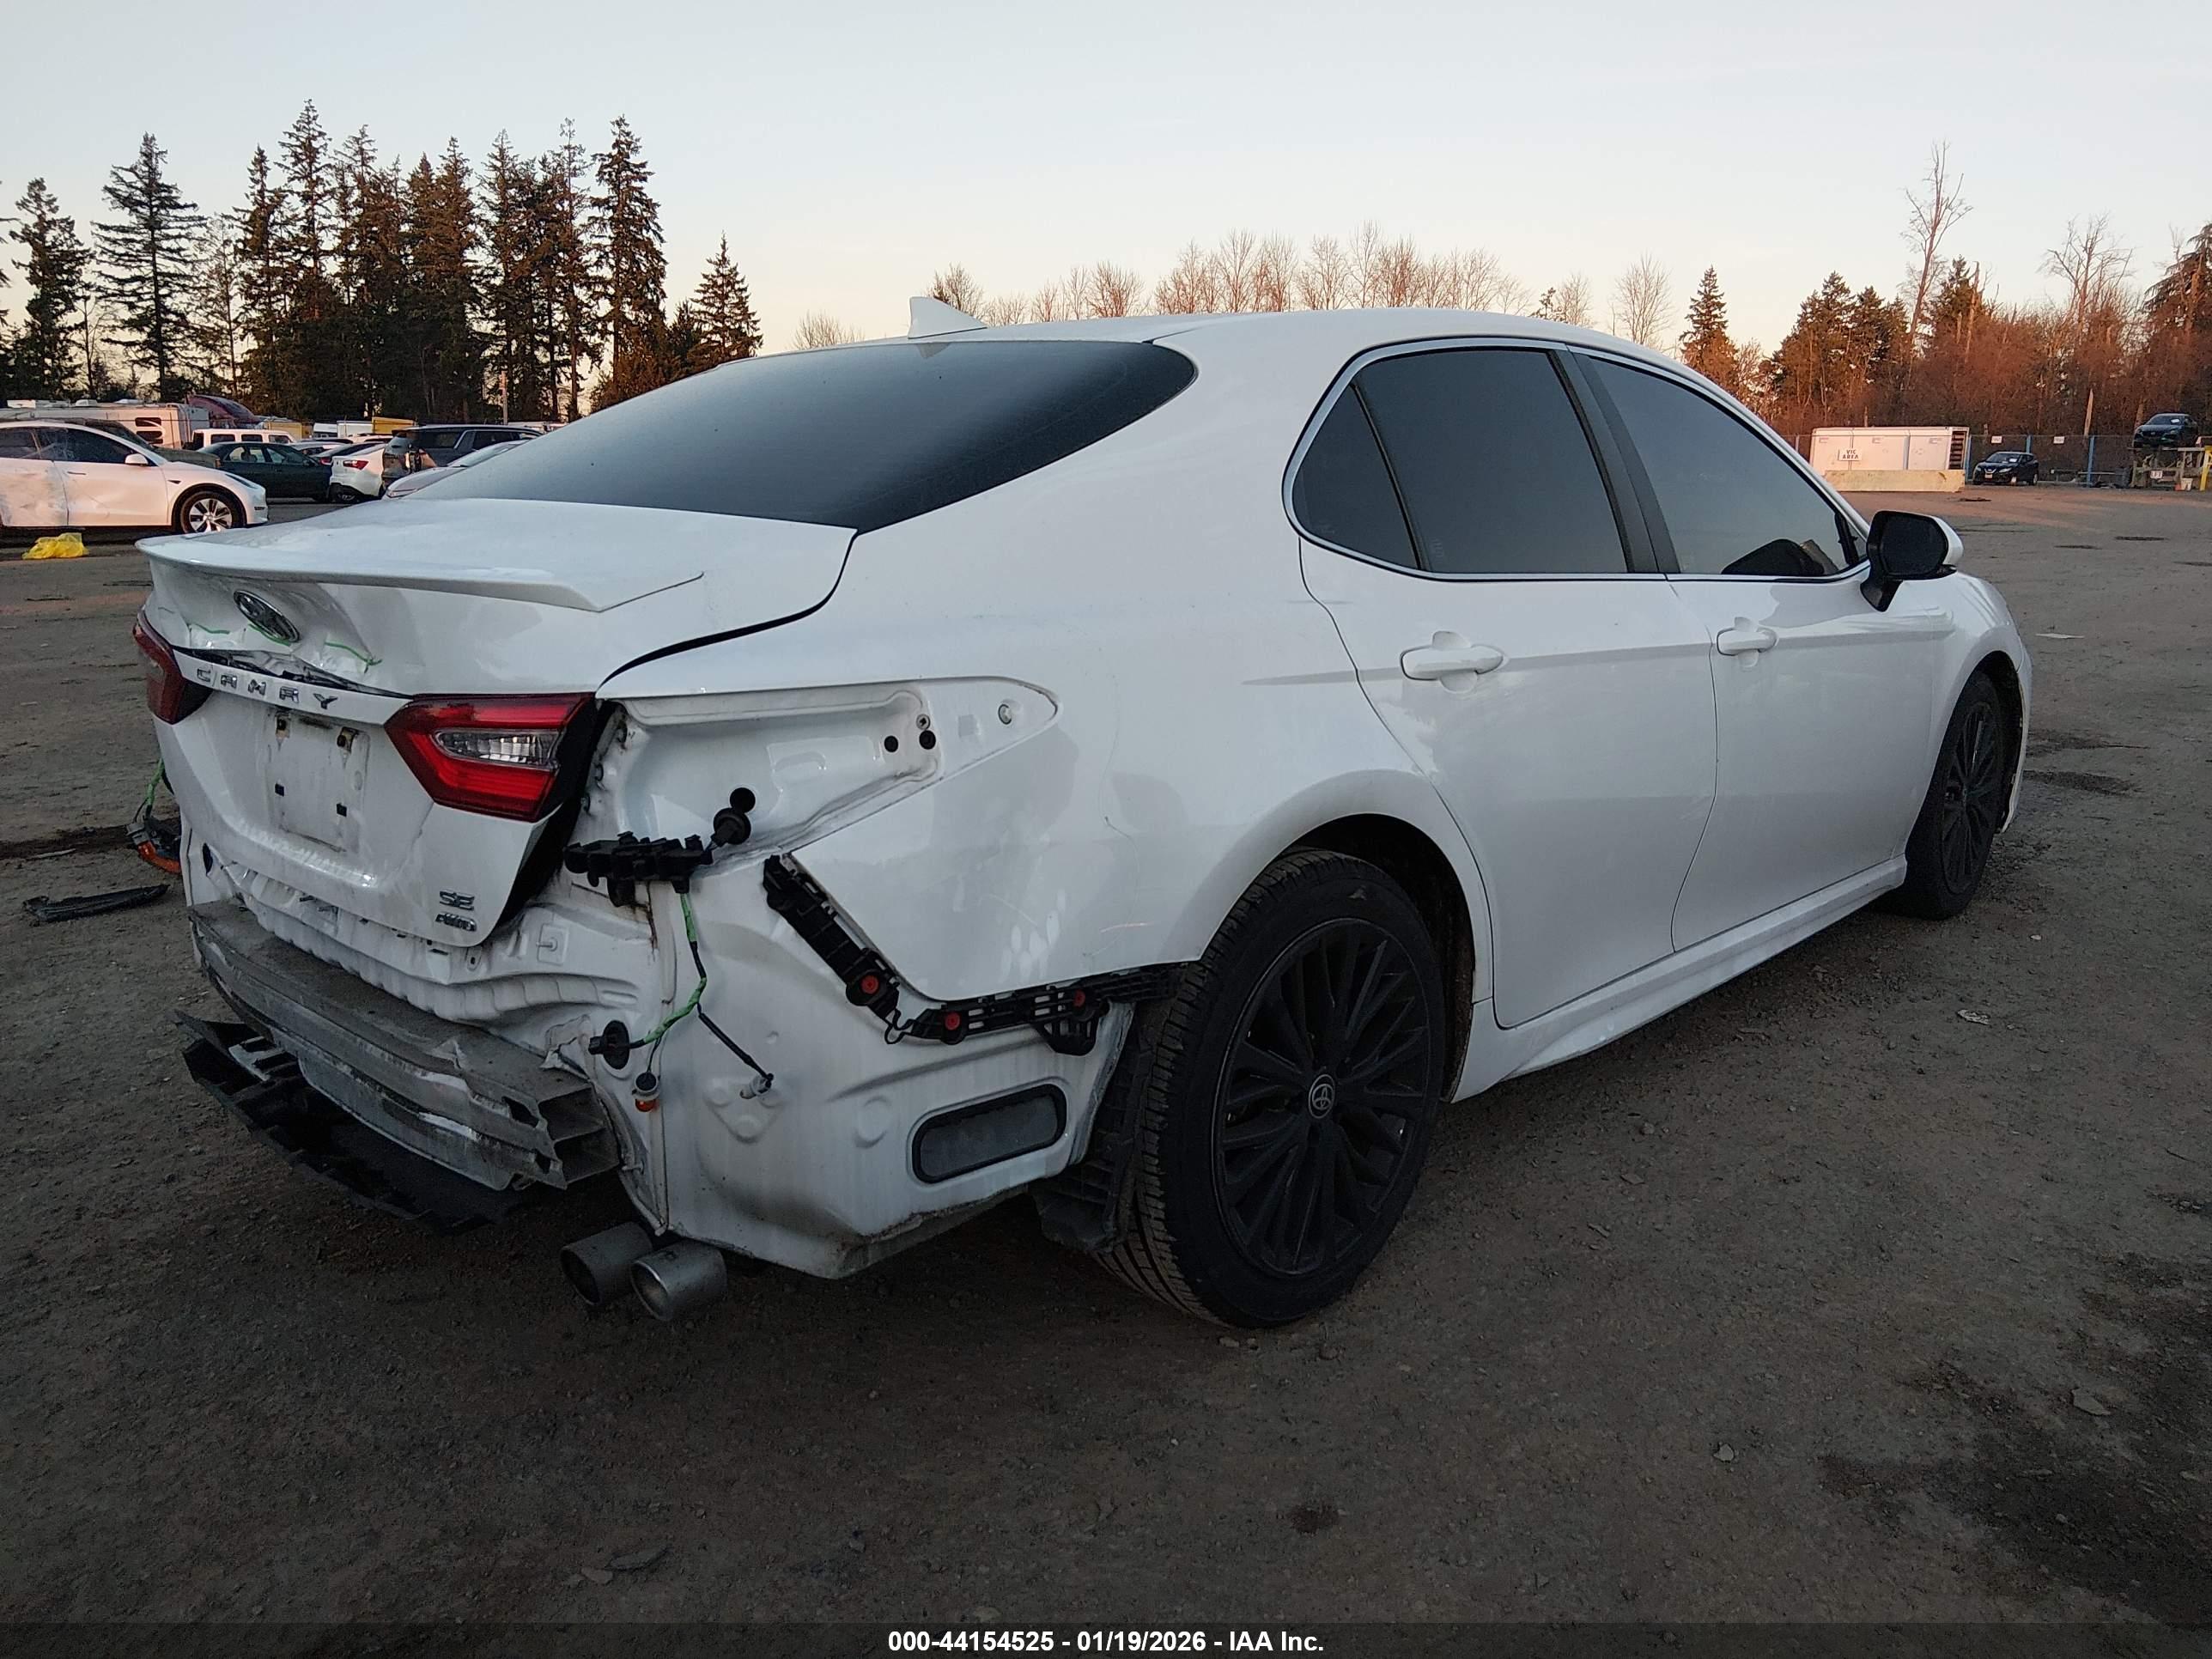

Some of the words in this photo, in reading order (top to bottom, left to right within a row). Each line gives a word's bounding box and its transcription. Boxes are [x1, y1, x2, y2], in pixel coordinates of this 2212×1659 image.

[197, 667, 338, 710] CAMRY
[439, 890, 475, 911] SE
[434, 913, 477, 932] AWD
